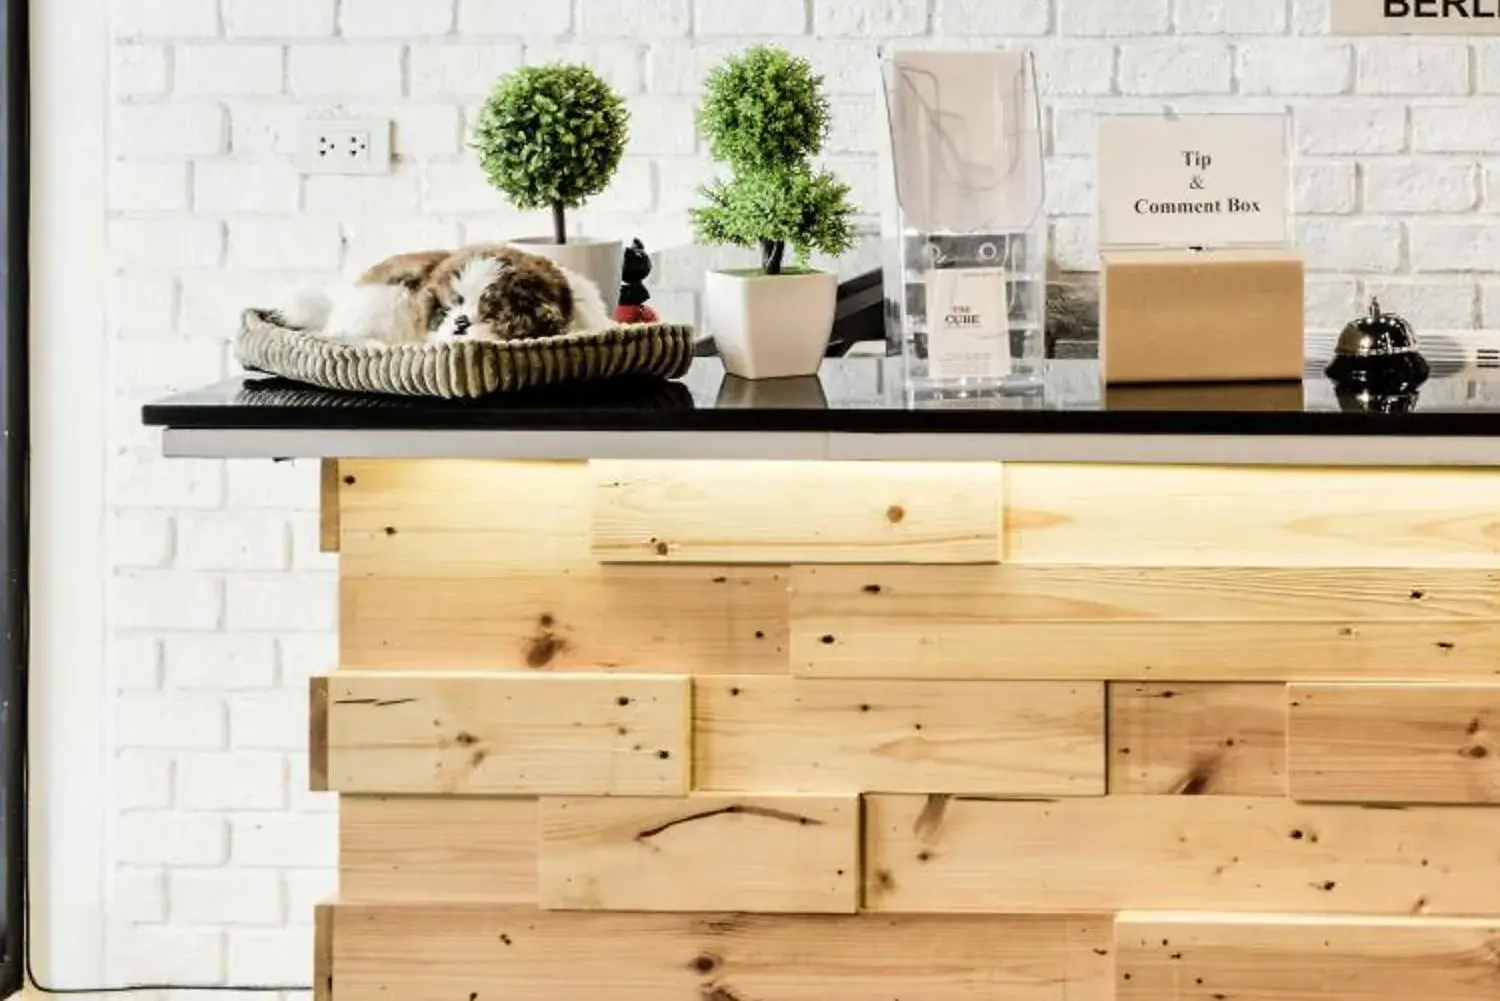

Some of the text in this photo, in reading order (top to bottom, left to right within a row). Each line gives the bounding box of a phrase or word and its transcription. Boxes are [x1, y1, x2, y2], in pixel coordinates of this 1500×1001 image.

[1182, 150, 1212, 171] Tip
[1189, 176, 1204, 190] &
[1133, 198, 1260, 214] Comment Box
